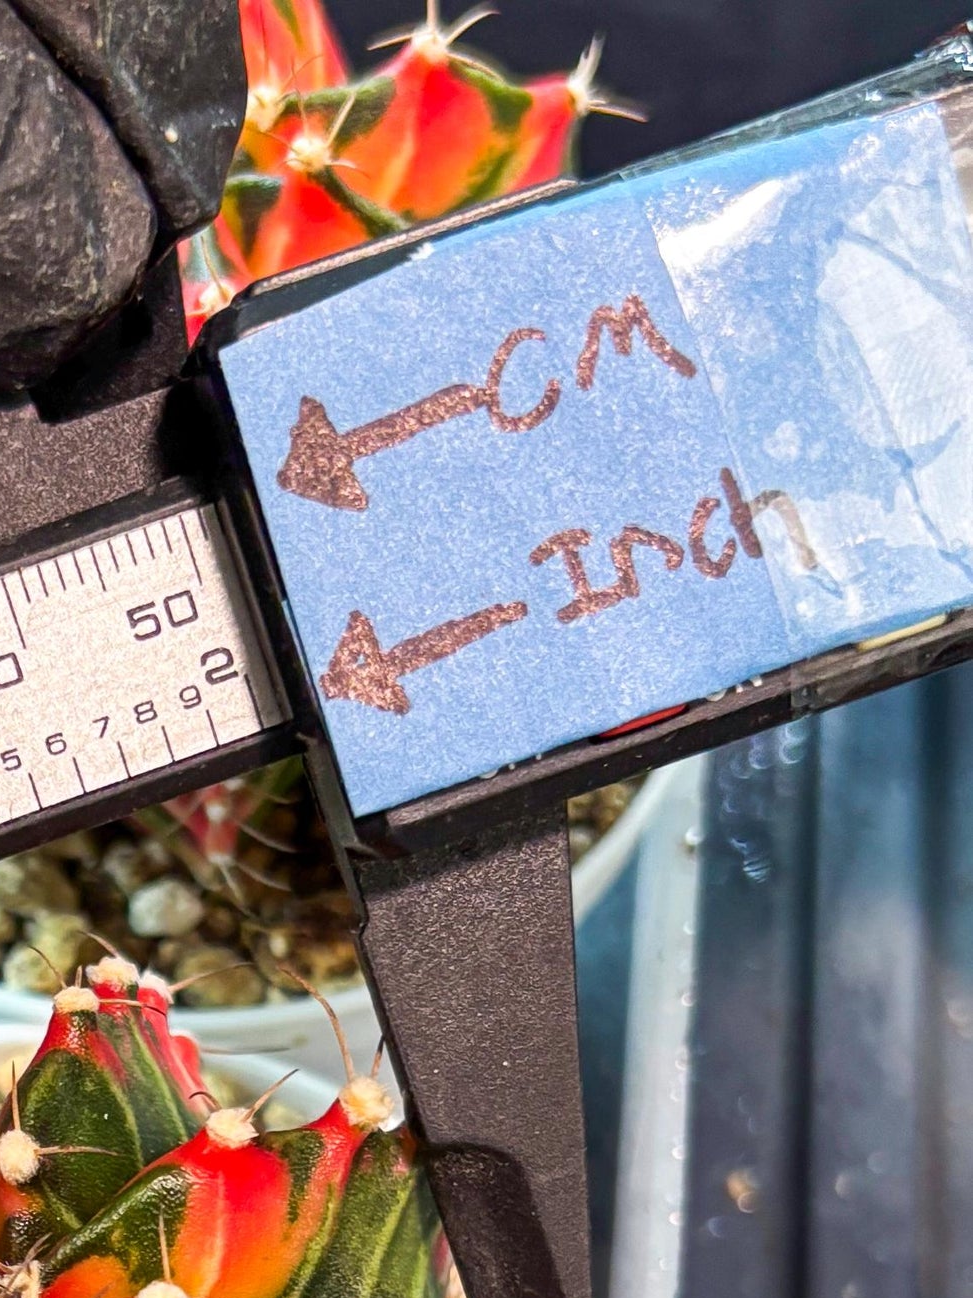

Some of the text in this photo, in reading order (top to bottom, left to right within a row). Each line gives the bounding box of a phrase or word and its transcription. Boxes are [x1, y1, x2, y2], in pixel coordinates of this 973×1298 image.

[529, 468, 817, 624] Inch
[126, 589, 199, 642] 50
[0, 748, 23, 772] 5
[44, 732, 68, 757] 6
[92, 716, 112, 739] 7
[133, 700, 159, 724] 8
[178, 685, 202, 710] 9
[199, 646, 239, 686] 2
